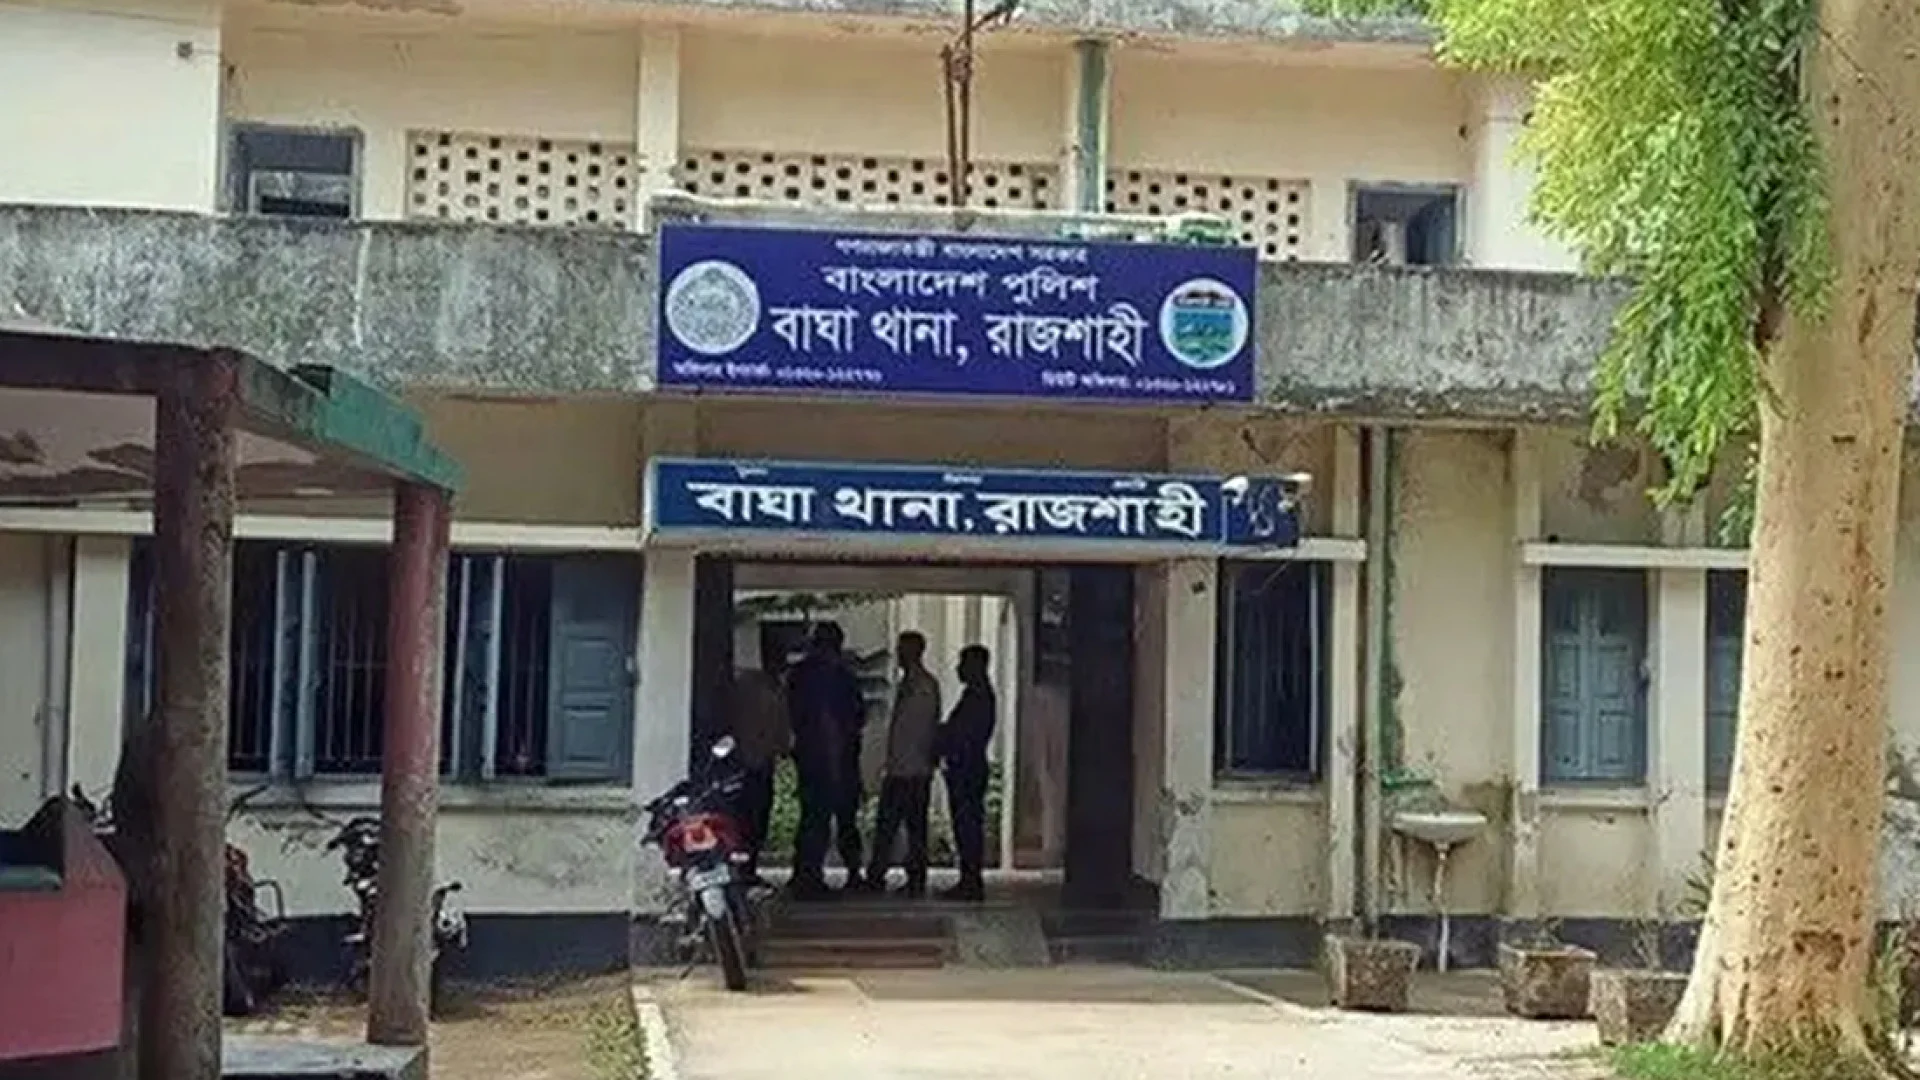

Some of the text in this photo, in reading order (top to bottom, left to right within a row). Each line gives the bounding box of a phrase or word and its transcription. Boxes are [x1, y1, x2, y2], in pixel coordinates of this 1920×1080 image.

[821, 265, 1099, 305] বাংলাদেশ পুলিশ
[768, 303, 1149, 367] বাঘা থানা, রাজশাহী
[687, 481, 816, 522] বাঘা
[976, 482, 1207, 537] রাজশাহী
